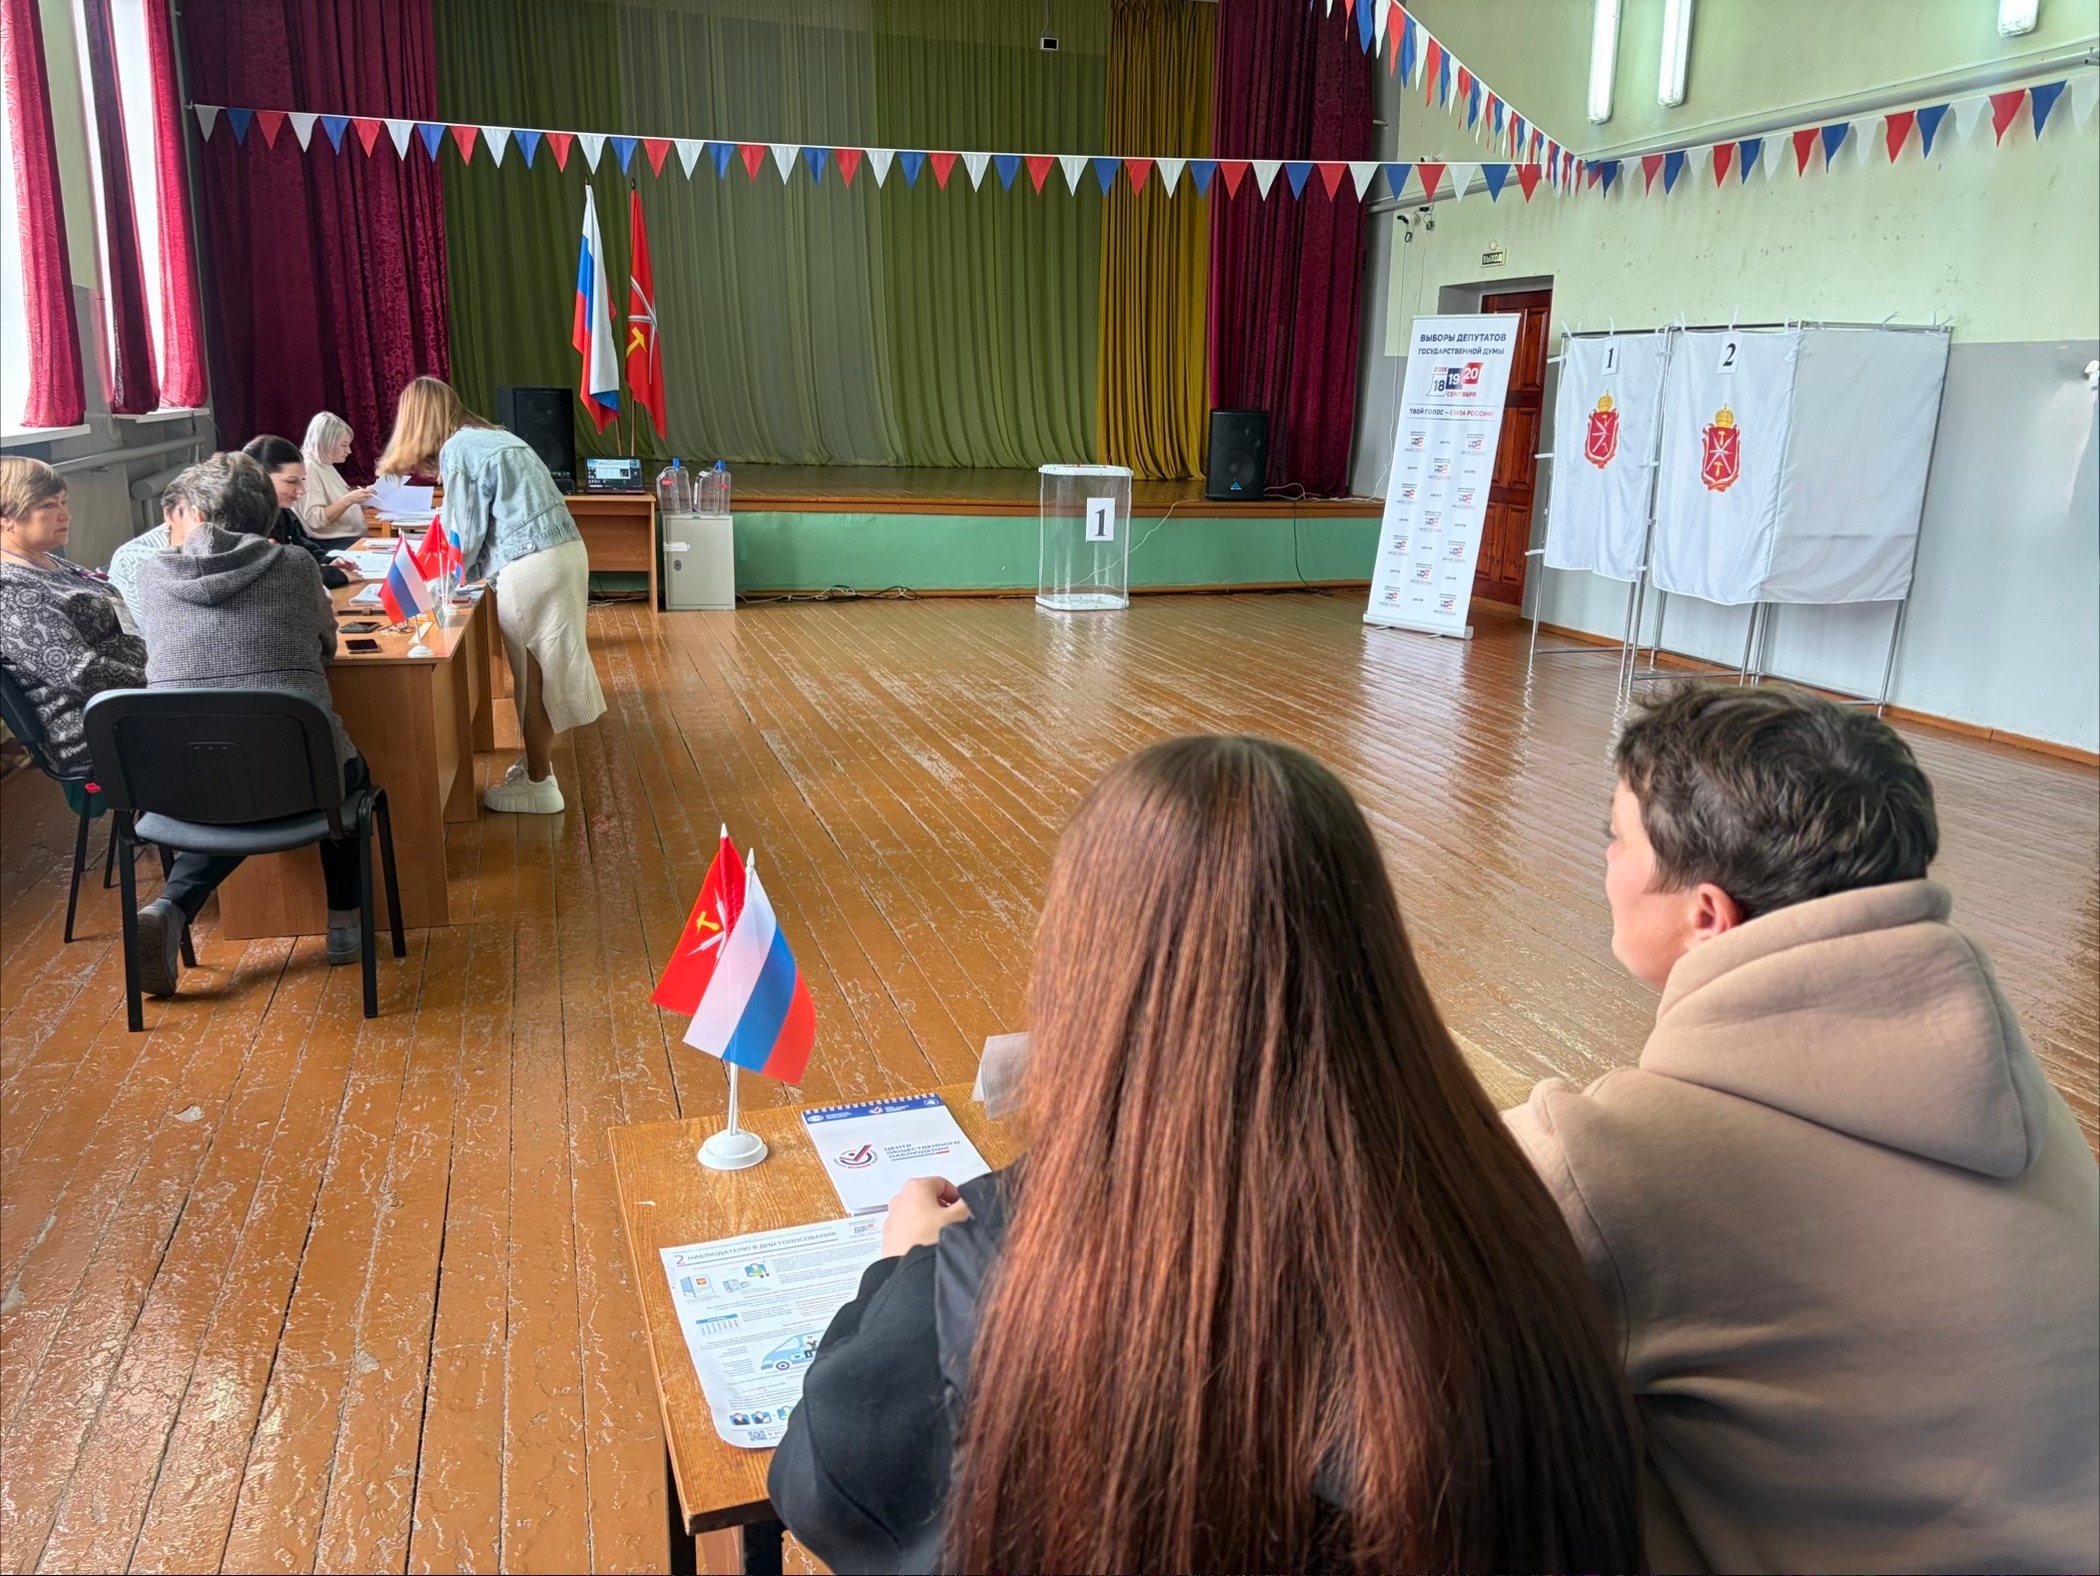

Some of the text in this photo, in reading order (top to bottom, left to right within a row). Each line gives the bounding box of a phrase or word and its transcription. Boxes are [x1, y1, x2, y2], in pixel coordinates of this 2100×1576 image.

[1420, 333, 1507, 343] ВЫБОРЫ ДЕПУТАТОВ
[1418, 347, 1504, 356] ГОСУДАРСТВЕННОЙ ДУМЫ
[1607, 347, 1615, 369] 1
[1722, 343, 1736, 367] 2
[1433, 367, 1479, 392] 18 19 20
[1409, 407, 1424, 415] ТВОЙ
[1424, 408, 1444, 416] ГОЛОС
[1449, 409, 1466, 417] СИЛА
[1093, 508, 1107, 537] 1
[884, 1143, 912, 1152] ЦЕНТР
[674, 1254, 685, 1265] 2
[687, 1245, 751, 1261] НАБЛЮДАТЕЛЮ
[759, 1241, 777, 1250] ДНИ
[778, 1231, 837, 1246] ГОЛОСОВАНИЯ
